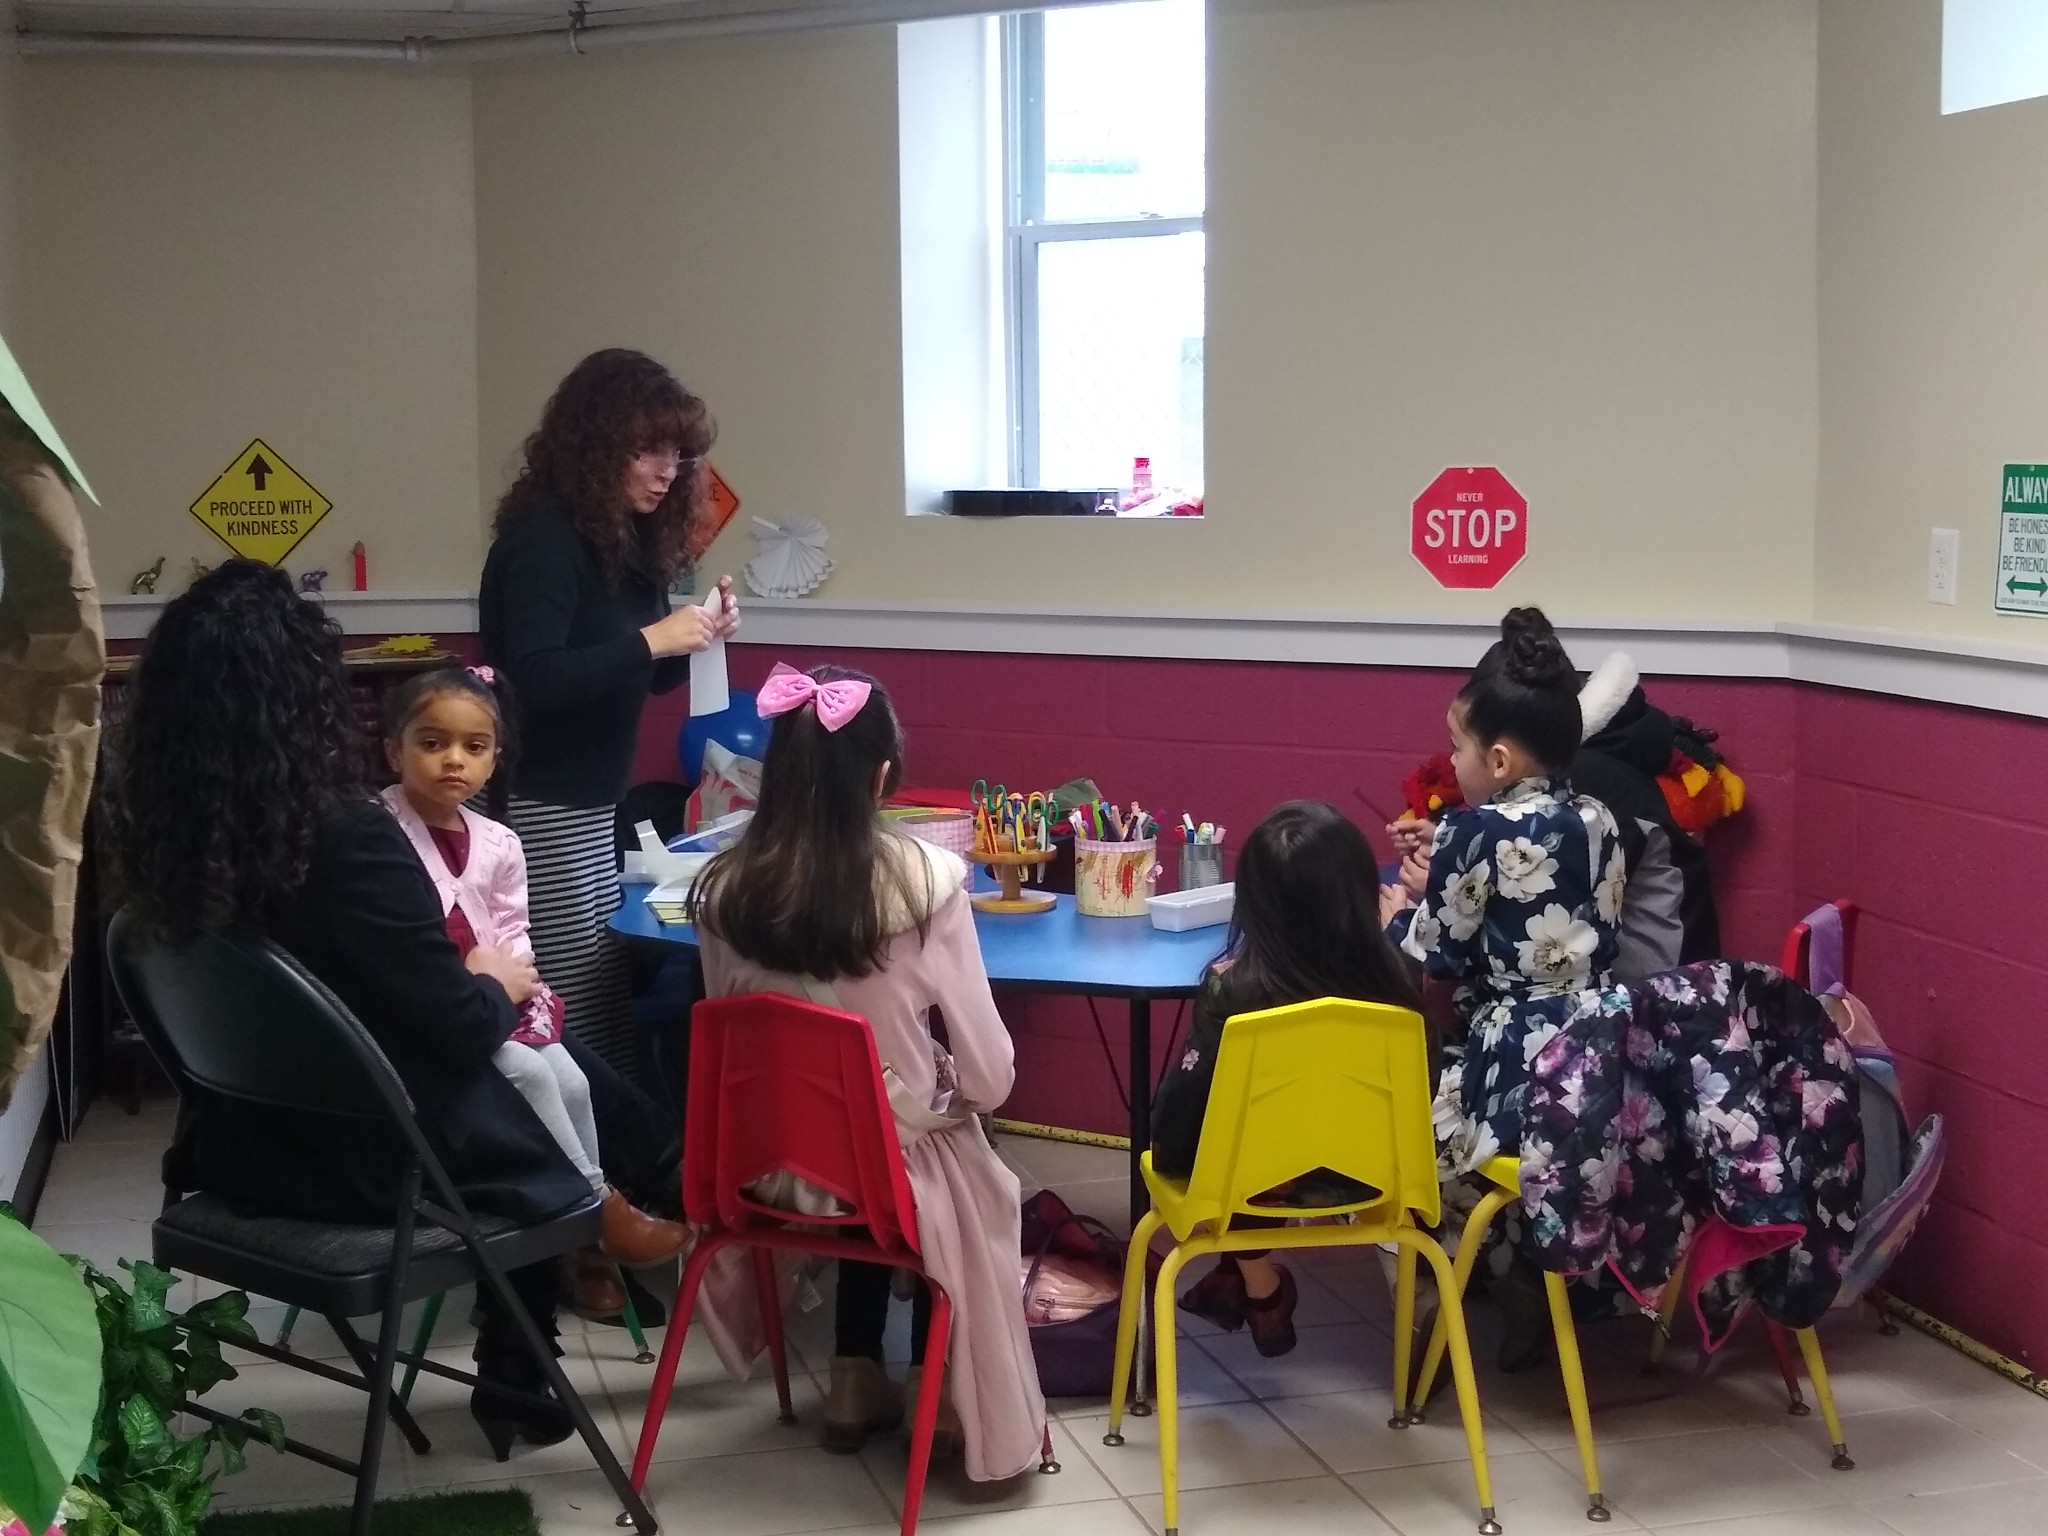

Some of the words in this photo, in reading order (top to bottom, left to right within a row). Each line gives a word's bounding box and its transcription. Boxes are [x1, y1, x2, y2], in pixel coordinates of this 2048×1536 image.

[1456, 492, 1484, 503] NEVER
[2004, 476, 2048, 504] ALWAY
[210, 500, 276, 517] PROCEED
[278, 499, 313, 515] WITH
[227, 519, 299, 537] KINDNESS
[1424, 508, 1518, 549] STOP
[2008, 517, 2020, 533] BE
[2020, 518, 2048, 535] HONES
[2013, 537, 2025, 553] BE
[2025, 537, 2047, 554] KIND
[1448, 554, 1489, 565] LEARNING
[2002, 555, 2014, 571] BE
[2014, 556, 2048, 574] FRIENDL
